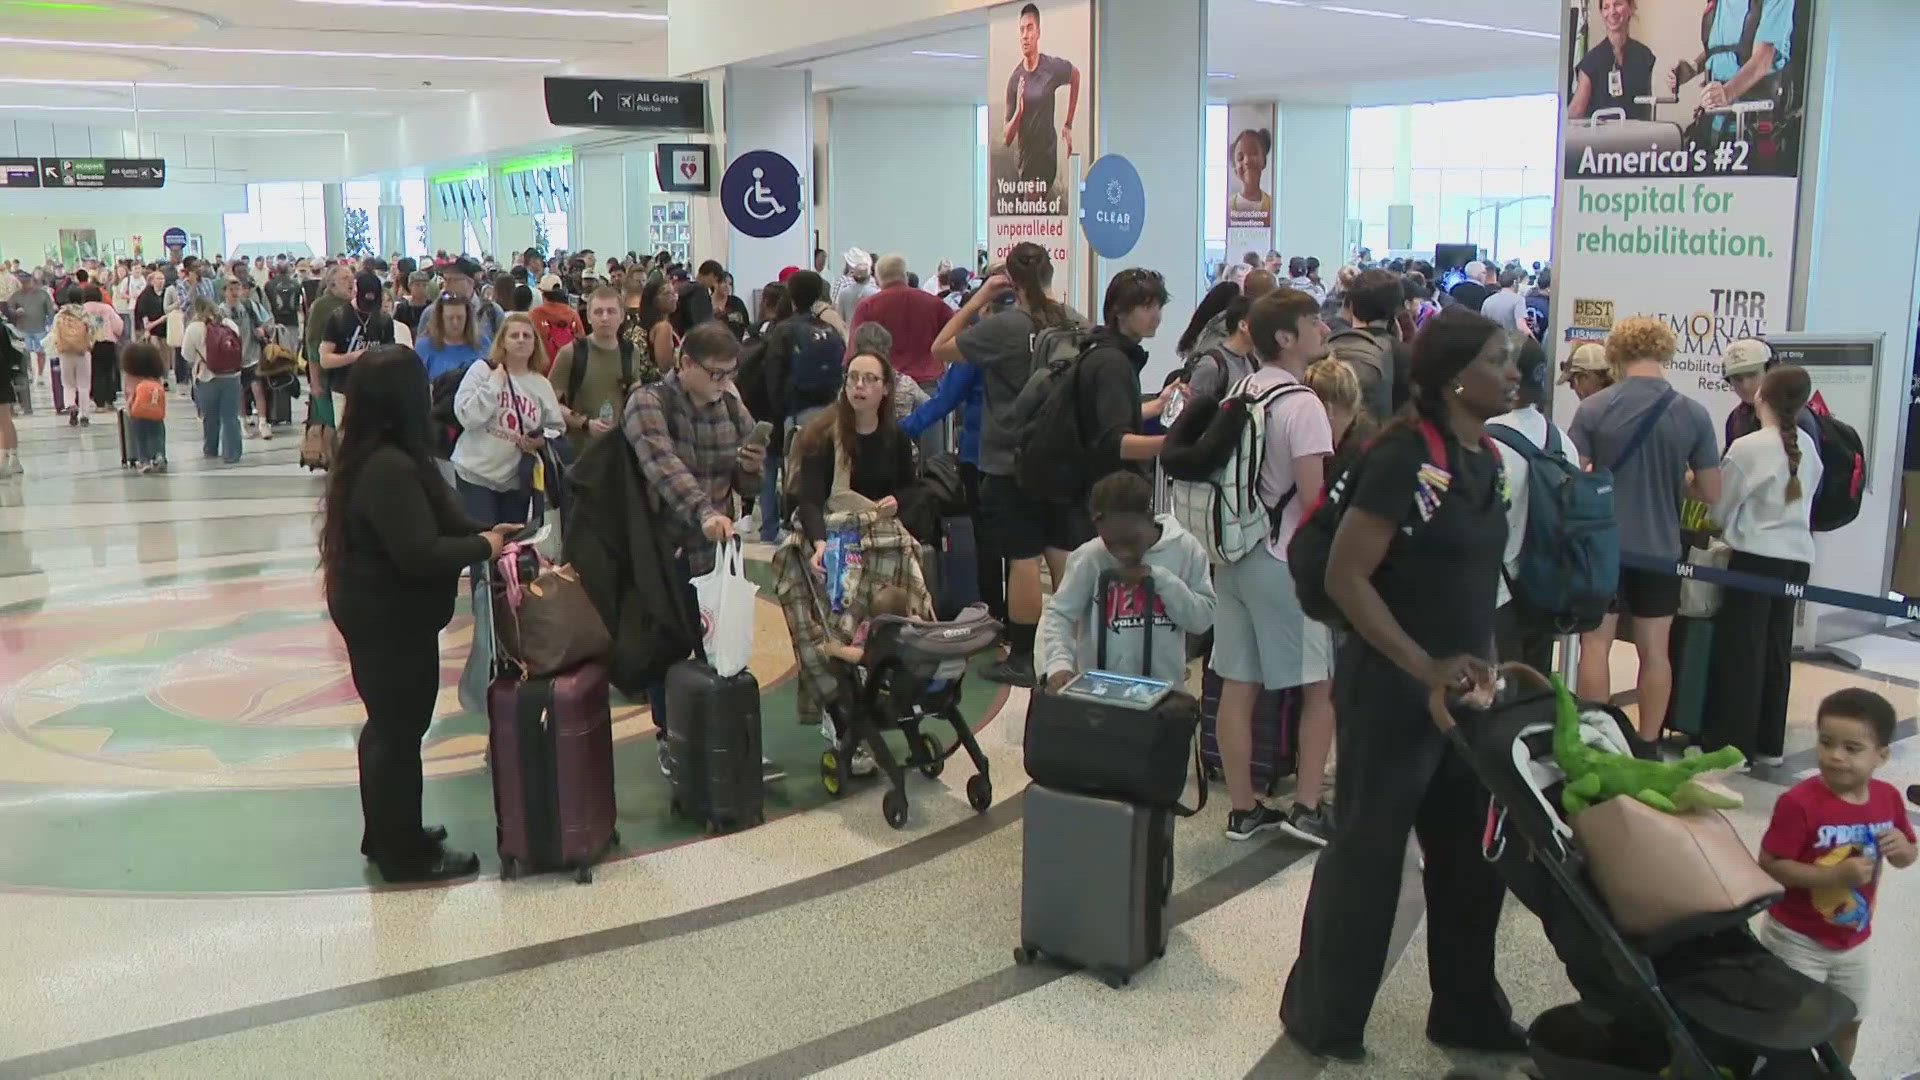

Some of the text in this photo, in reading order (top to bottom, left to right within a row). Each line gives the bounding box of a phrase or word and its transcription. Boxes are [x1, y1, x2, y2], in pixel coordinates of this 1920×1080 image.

[637, 93, 679, 103] All Gates
[1577, 140, 1750, 174] America's #2
[997, 177, 1047, 194] You are in
[997, 196, 1061, 214] the hands of
[1578, 182, 1734, 222] hospital for
[1096, 210, 1130, 224] CLEAR
[997, 218, 1064, 240] unparalleled
[1576, 224, 1774, 258] rehabilitation.
[1053, 247, 1068, 260] ca
[1574, 299, 1614, 316] BEST
[1709, 288, 1766, 318] TIRR
[1637, 311, 1767, 338] EMORIAL
[1788, 351, 1805, 359] Only
[1676, 563, 1694, 578] IAH
[1785, 583, 1804, 598] IAH
[1907, 604, 1920, 619] IA
